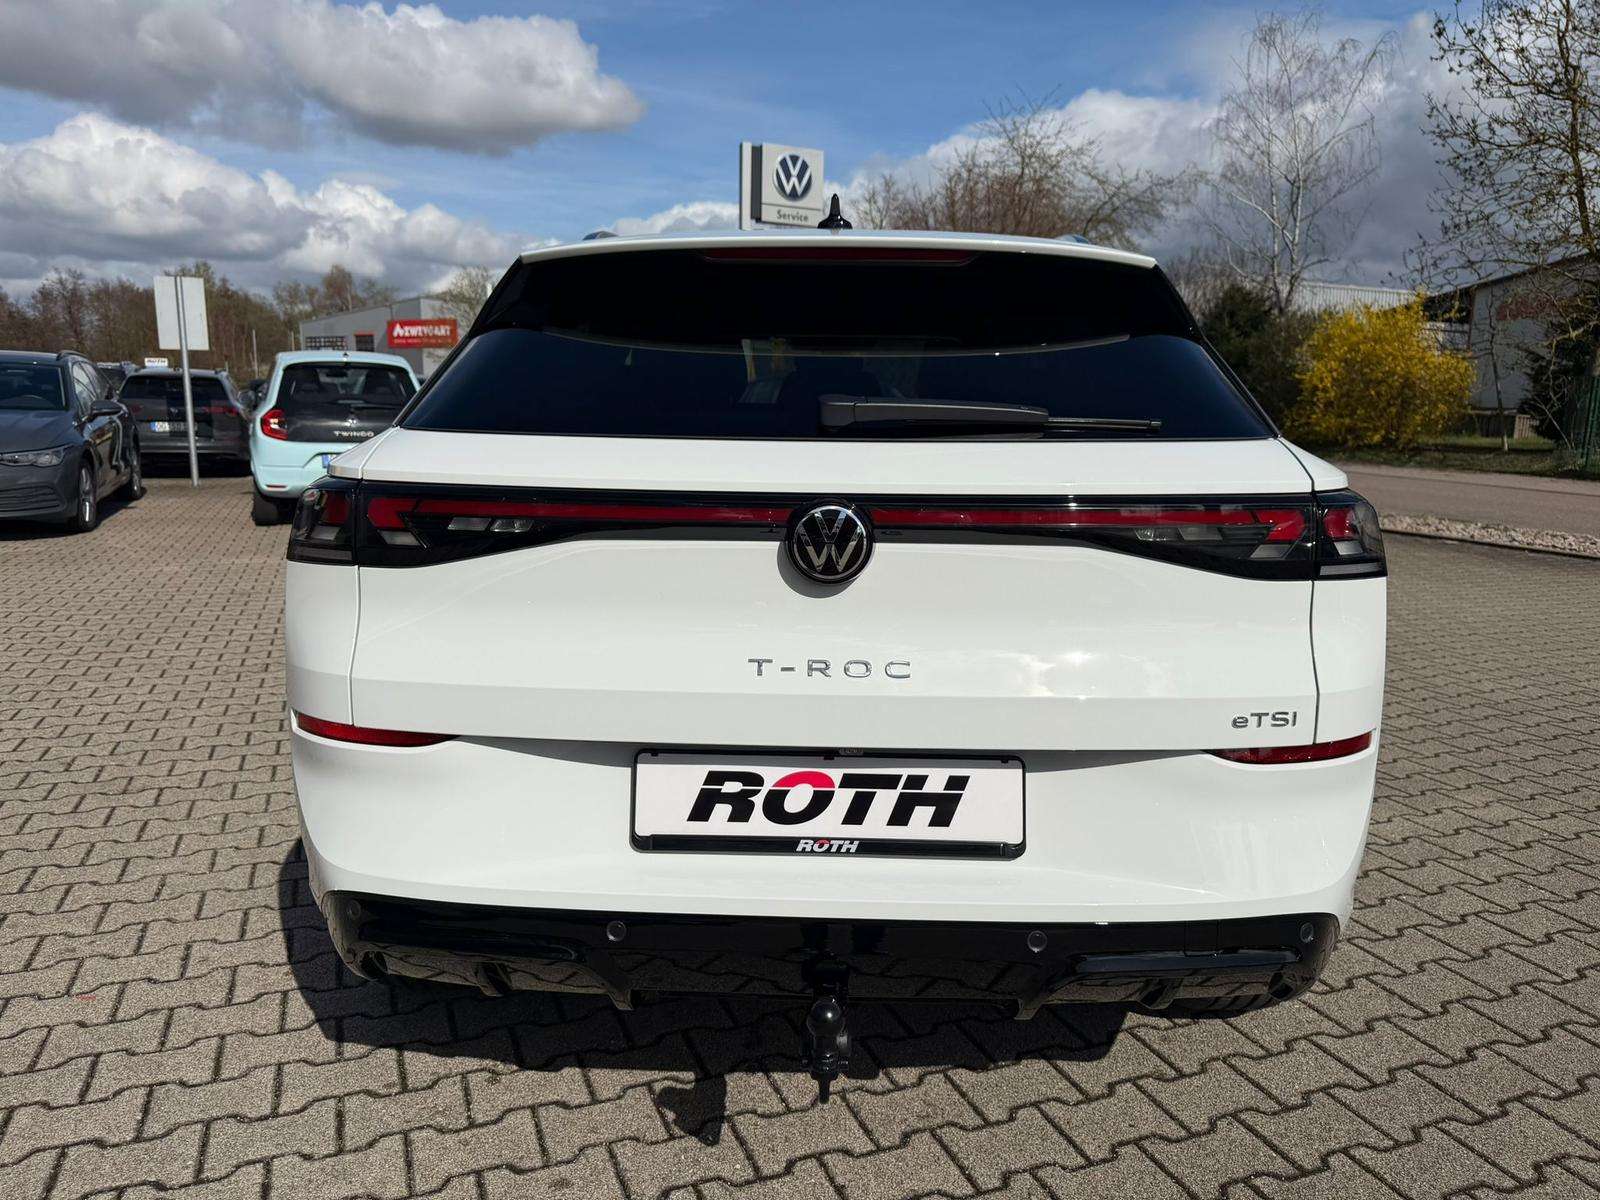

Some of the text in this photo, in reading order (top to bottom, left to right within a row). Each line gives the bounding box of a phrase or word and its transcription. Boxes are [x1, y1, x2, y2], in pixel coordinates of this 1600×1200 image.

[776, 209, 809, 222] Service
[333, 430, 375, 438] TWINGO
[747, 658, 912, 679] T-ROC
[1230, 711, 1298, 729] eTSI
[686, 769, 971, 828] ROTH
[795, 838, 860, 853] ROTH
